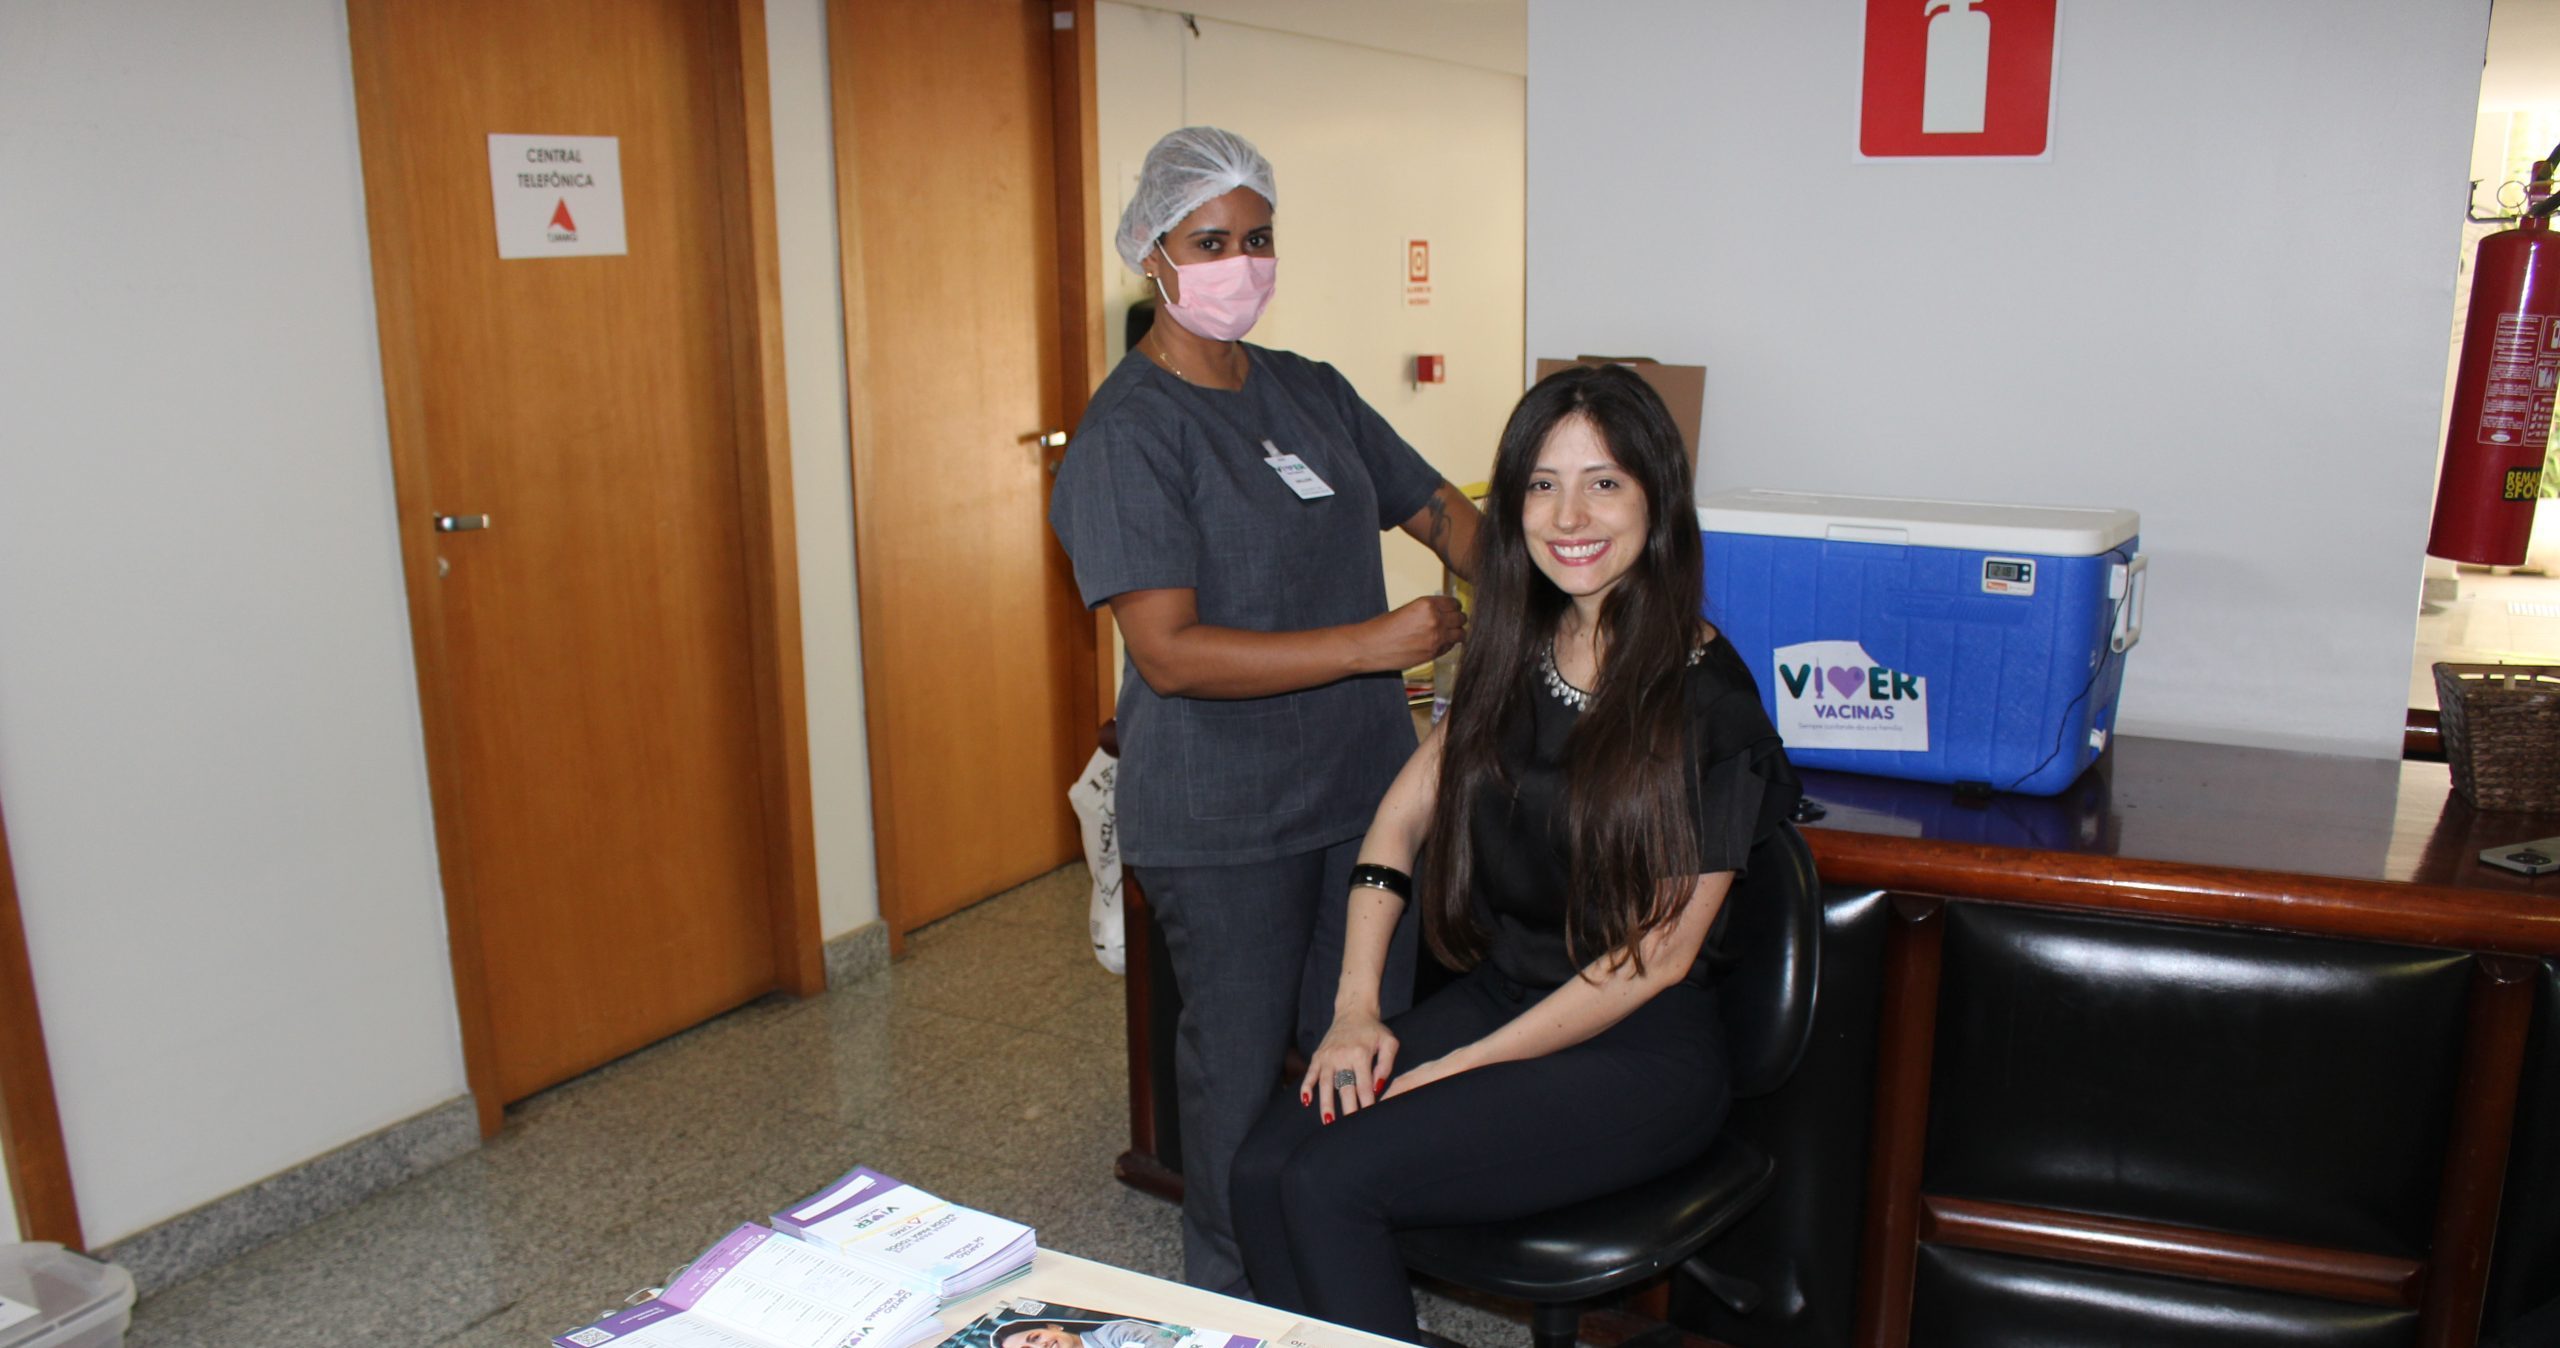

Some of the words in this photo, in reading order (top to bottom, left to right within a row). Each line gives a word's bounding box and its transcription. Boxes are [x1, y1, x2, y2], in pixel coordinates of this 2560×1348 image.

[526, 148, 582, 163] CENTRAL
[517, 171, 594, 188] TELEFÔNICA
[1814, 704, 1895, 720] VACINAS
